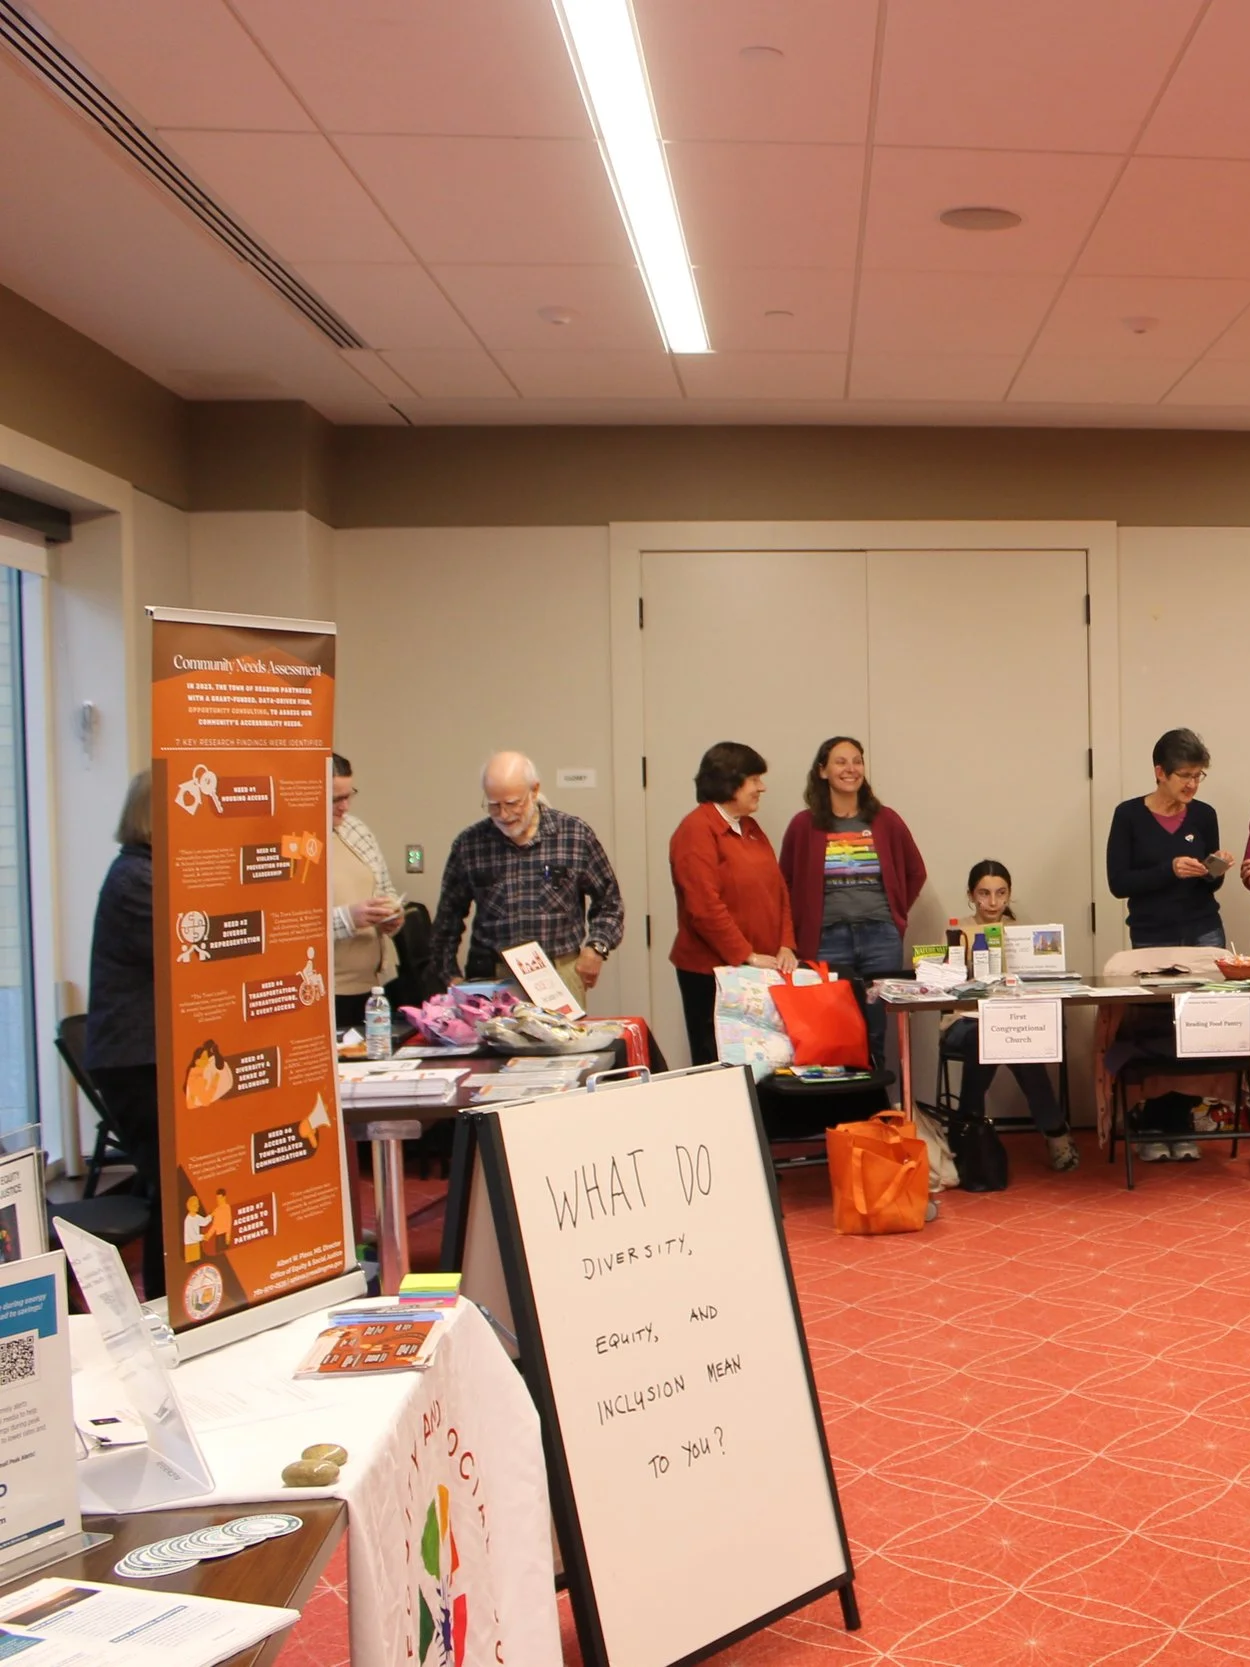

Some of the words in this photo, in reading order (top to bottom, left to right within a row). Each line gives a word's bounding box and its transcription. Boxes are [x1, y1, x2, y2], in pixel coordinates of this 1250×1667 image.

[173, 654, 234, 674] Community
[236, 657, 266, 673] Needs
[268, 660, 321, 677] Assessment
[216, 683, 227, 691] THE
[228, 684, 244, 692] TOWN
[245, 684, 253, 692] OF
[254, 685, 279, 693] READING
[280, 686, 312, 695] PARTNERED
[187, 694, 204, 702] WITH
[188, 706, 230, 714] OPPORTUNITY
[279, 708, 300, 716] ASSESS
[301, 709, 312, 717] OUR
[198, 718, 239, 726] COMMUNITY'S
[240, 719, 282, 727] ACCESSIBILITY
[182, 738, 197, 746] KEY
[199, 738, 235, 746] RESEARCH
[236, 739, 268, 747] FINDINGS
[269, 739, 288, 747] WERE
[288, 739, 324, 748] IDENTIFIED
[246, 862, 276, 871] PREVENTION
[276, 861, 290, 869] FROM
[252, 870, 282, 879] LEADERSHIP
[223, 919, 239, 928] NEED
[222, 928, 247, 938] DIVERSE
[210, 936, 261, 949] REPRESENTATION
[261, 981, 275, 989] NEED
[256, 1007, 273, 1016] EVENT
[274, 1003, 296, 1013] ACCESS
[991, 1025, 1046, 1033] Congregational
[1005, 1036, 1032, 1044] Church
[240, 1055, 256, 1064] NEED
[235, 1062, 265, 1074] DIVERSITY
[239, 1071, 257, 1081] SENSE
[258, 1070, 266, 1078] OF
[237, 1078, 270, 1090] BELONGING
[268, 1129, 283, 1138] NEED
[264, 1138, 287, 1149] ACCESS
[258, 1141, 303, 1159] TOWN-RELATED
[255, 1150, 307, 1169] COMMUNICATIONS
[546, 1149, 646, 1231] WHAT
[676, 1144, 712, 1206] DO
[237, 1204, 255, 1215] NEED
[233, 1213, 259, 1226] ACCESS
[259, 1210, 269, 1218] TO
[238, 1221, 264, 1233] CAREER
[234, 1228, 269, 1244] PATHWAYS
[276, 1257, 292, 1267] Albert
[322, 1241, 342, 1252] Director
[582, 1233, 693, 1280] DIVERSITY,
[270, 1270, 285, 1280] Office
[285, 1267, 292, 1275] of
[291, 1263, 307, 1274] Equity
[311, 1254, 327, 1265] Social
[326, 1250, 343, 1261] Justice
[24, 1293, 47, 1305] energy
[17, 1302, 44, 1316] savings!
[595, 1322, 660, 1355] EQUITY,
[689, 1305, 718, 1322] AND
[597, 1374, 685, 1426] INCLUSION
[706, 1354, 742, 1383] MEAN
[649, 1455, 670, 1479] TO
[681, 1426, 725, 1467] YOU?
